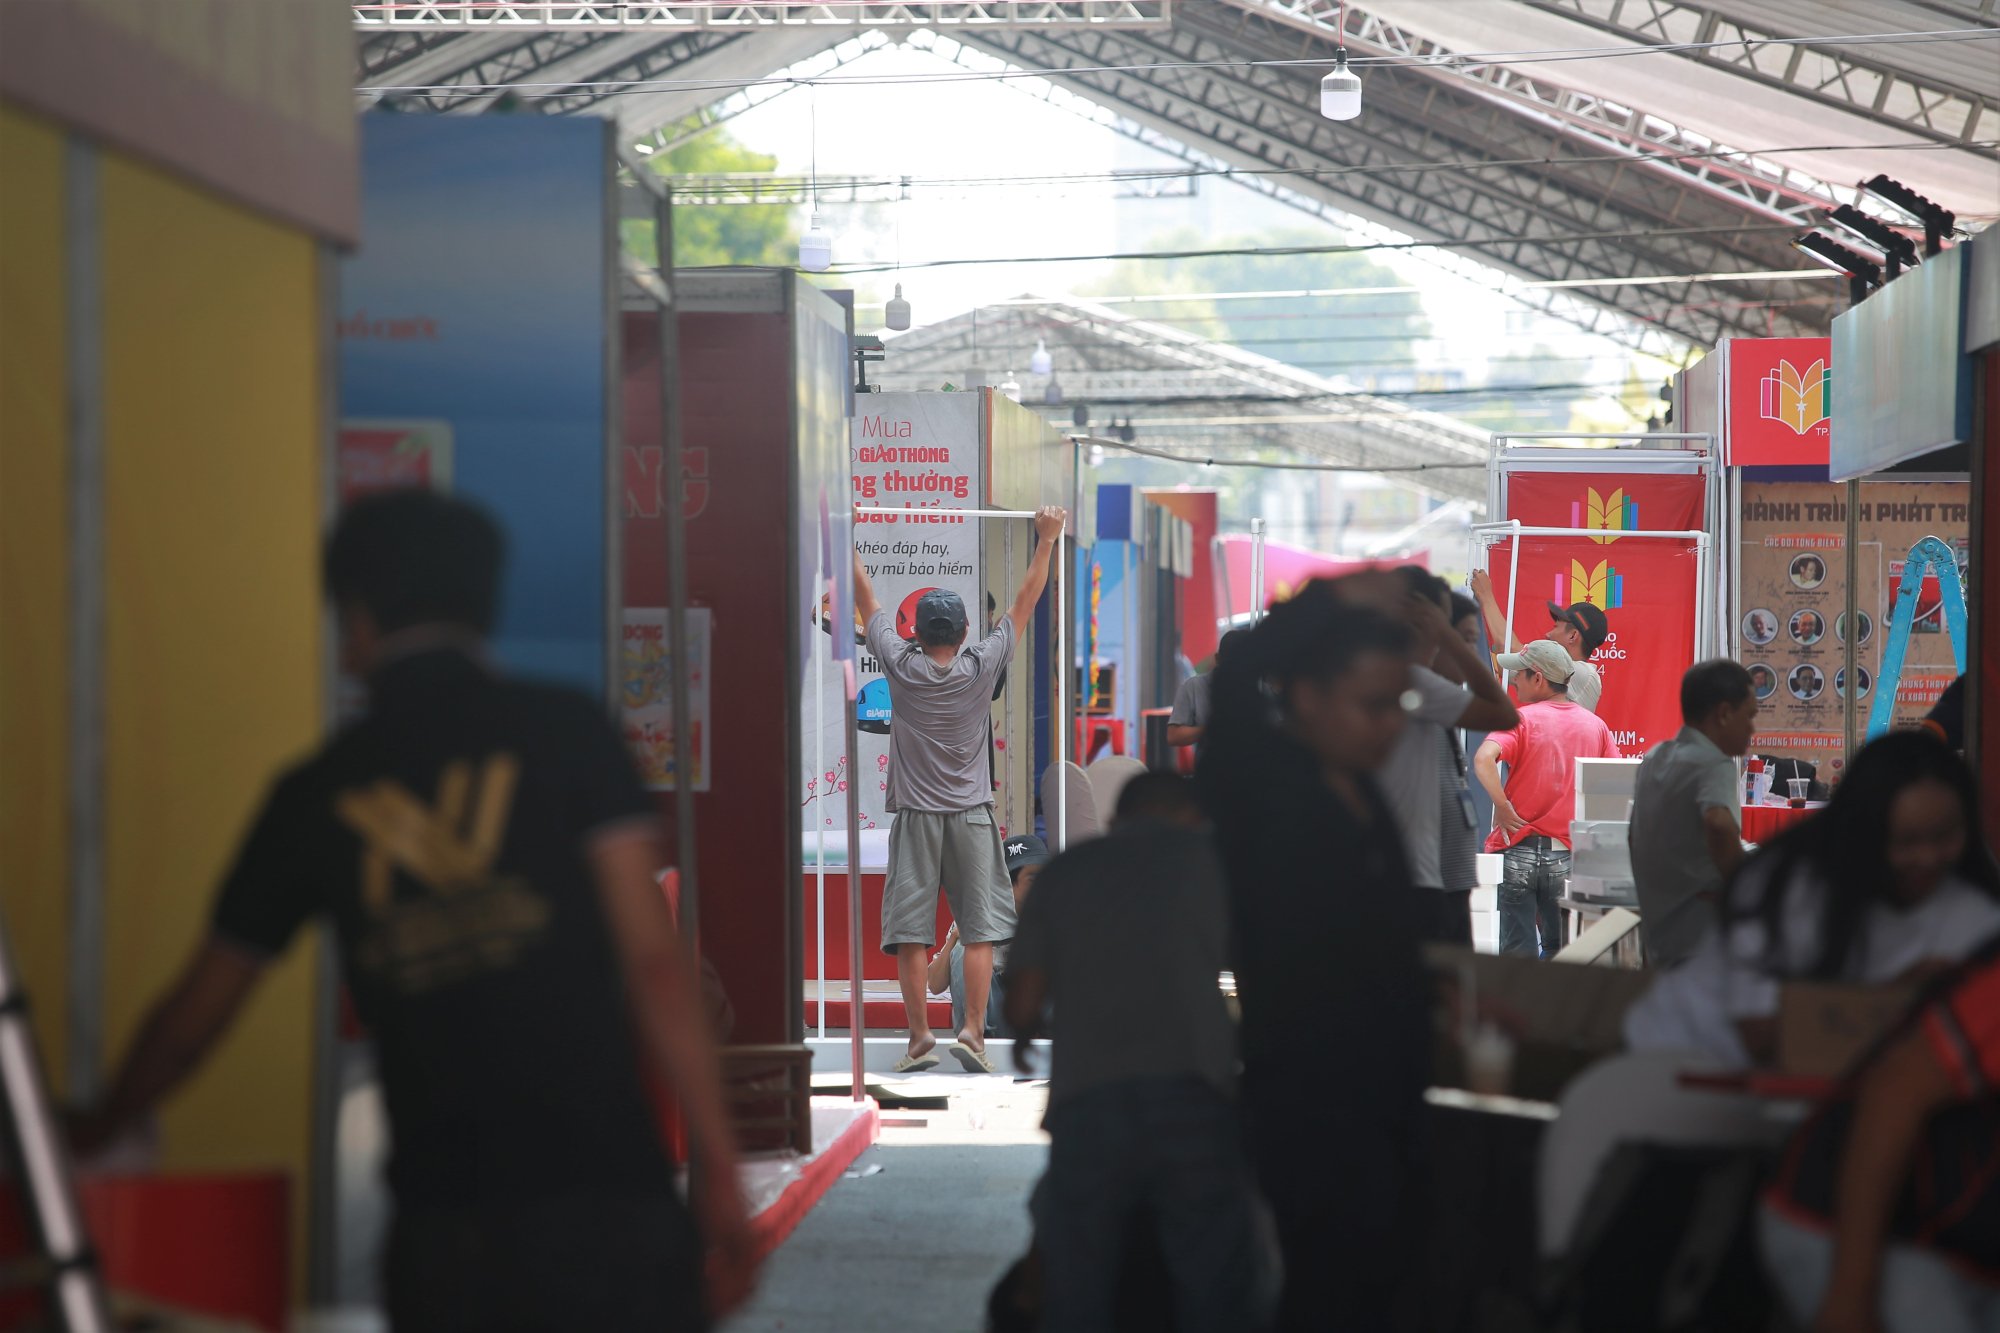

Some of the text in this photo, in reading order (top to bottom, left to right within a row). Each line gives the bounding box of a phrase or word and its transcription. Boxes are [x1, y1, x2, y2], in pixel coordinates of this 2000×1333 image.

[863, 415, 912, 438] Mua
[883, 469, 969, 498] thưởng
[1876, 495, 1936, 522] PHÁT
[855, 541, 950, 558] khéo đáp hay,
[882, 562, 905, 575] mũ
[909, 562, 934, 575] bảo
[938, 561, 973, 575] hiểm
[1589, 643, 1627, 661] Quốc
